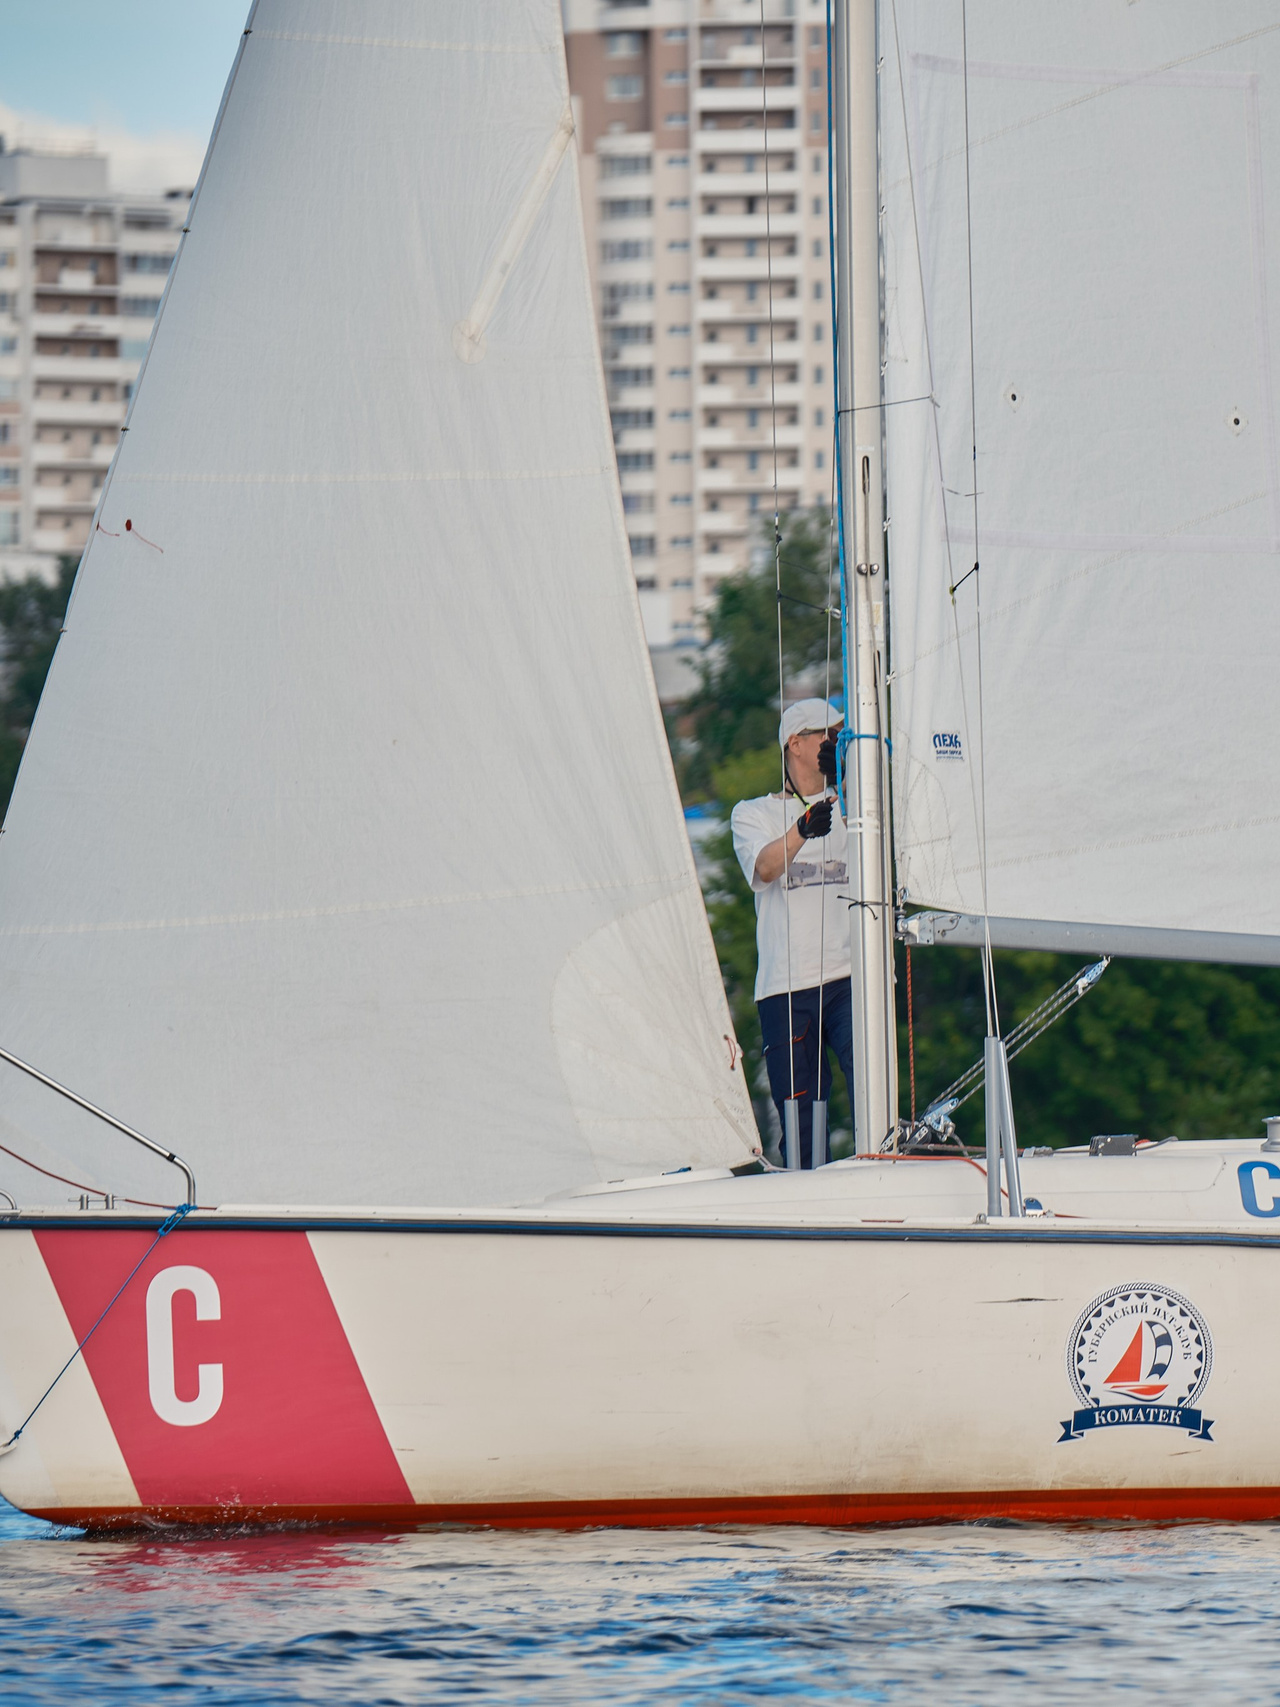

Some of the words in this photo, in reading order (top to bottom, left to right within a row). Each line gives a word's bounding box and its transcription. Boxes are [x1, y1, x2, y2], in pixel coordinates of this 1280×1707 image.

[1088, 1302, 1148, 1363] ГУБЕРНСКИЙ
[1152, 1307, 1192, 1360] ЯХТ-КЛУБ
[1094, 1408, 1182, 1425] КОМАТЕК
